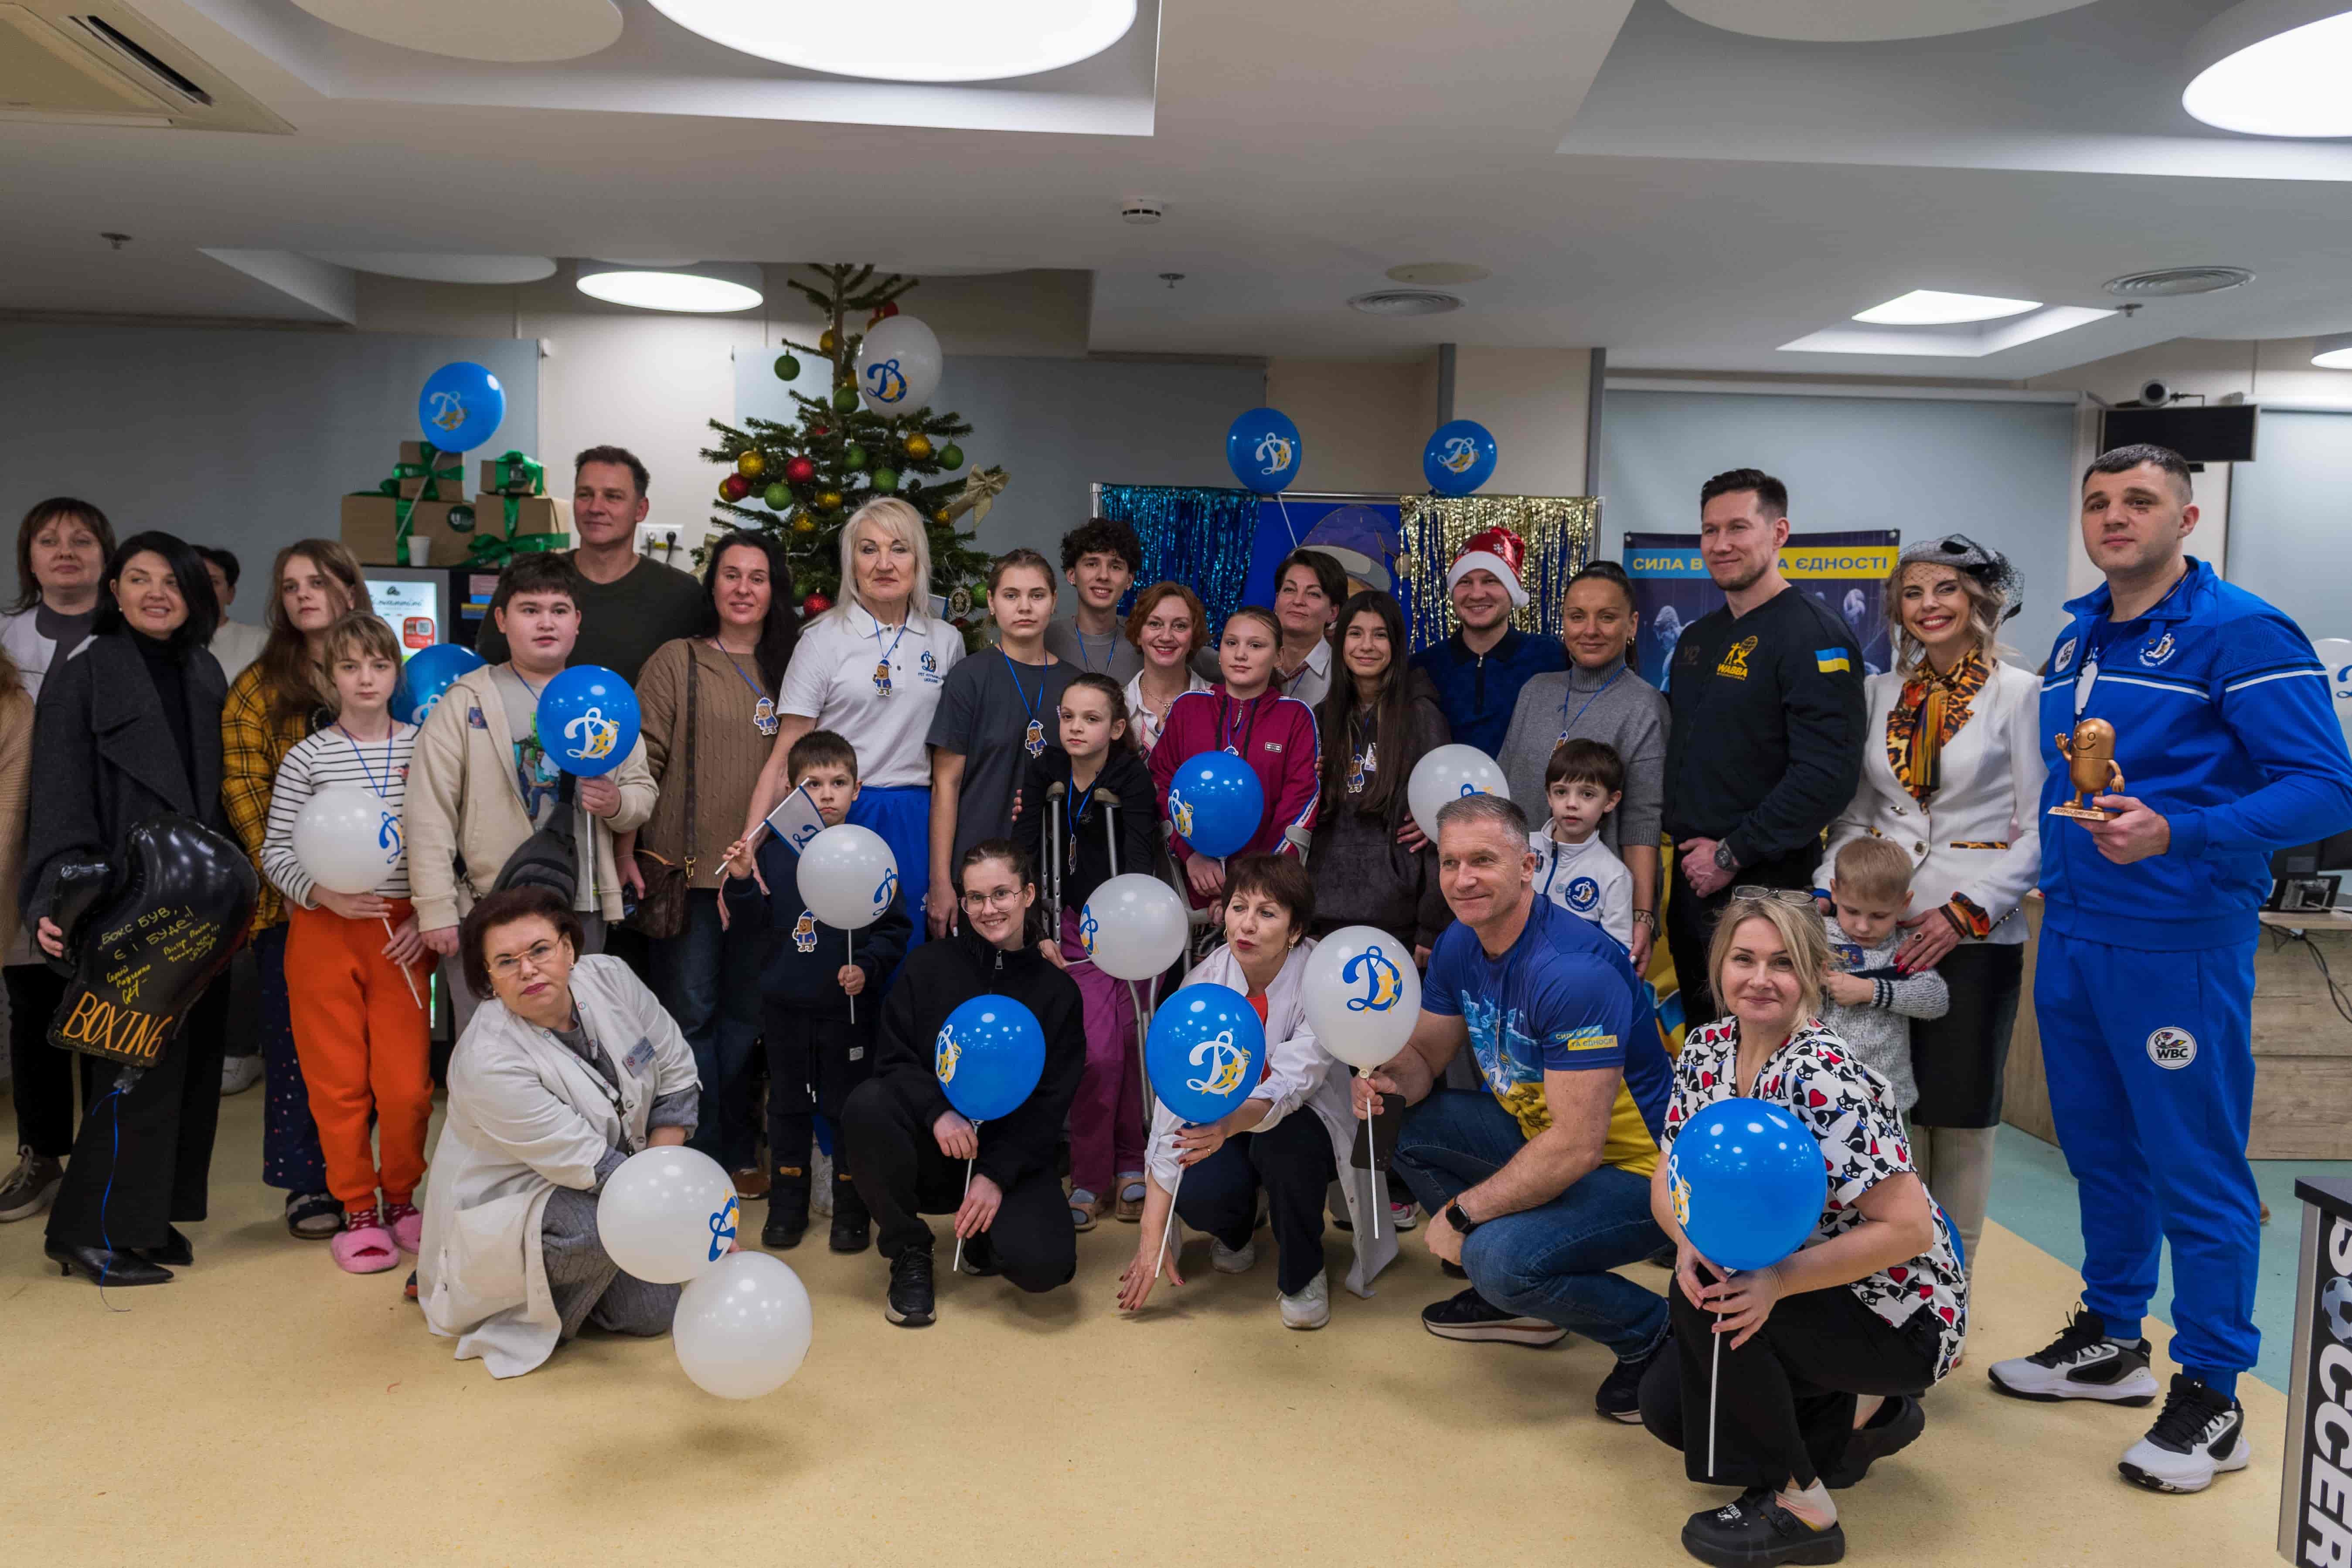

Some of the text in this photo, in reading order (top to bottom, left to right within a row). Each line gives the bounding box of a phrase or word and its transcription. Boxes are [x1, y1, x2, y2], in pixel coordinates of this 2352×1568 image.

[1633, 558, 1684, 570] СИЛА
[1691, 558, 1703, 570] В
[1795, 557, 1887, 572] ЄДНОСТІ
[1717, 663, 1748, 677] WABBA
[63, 991, 174, 1058] BOXING
[2156, 1048, 2189, 1058] WBC
